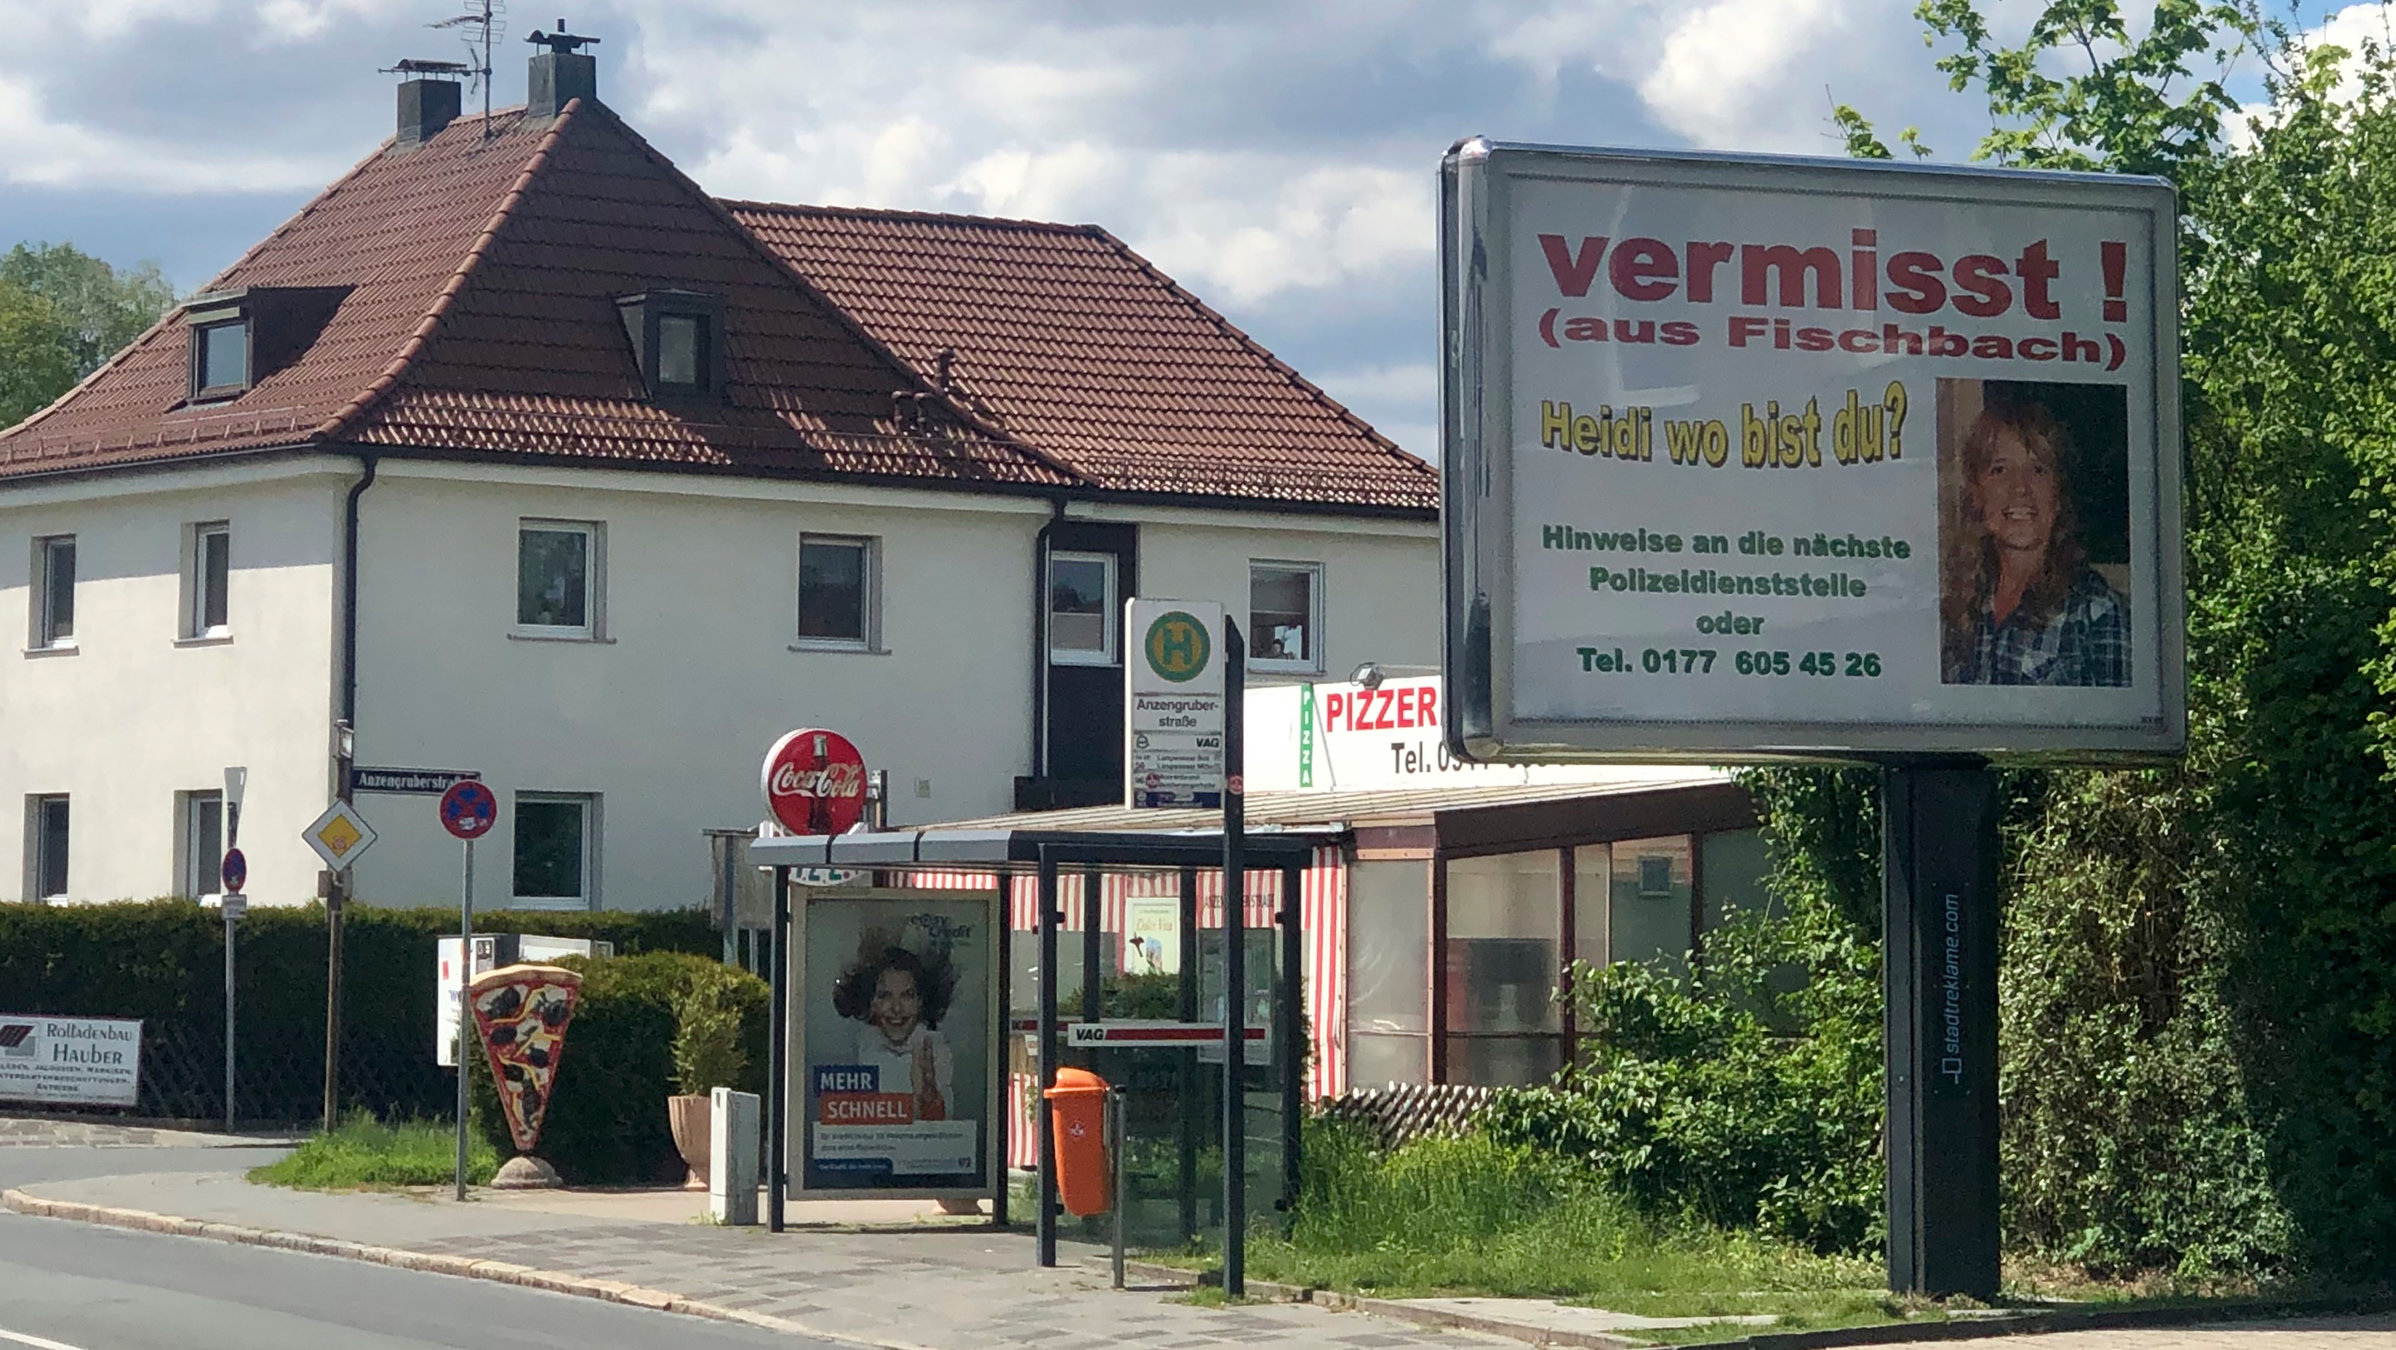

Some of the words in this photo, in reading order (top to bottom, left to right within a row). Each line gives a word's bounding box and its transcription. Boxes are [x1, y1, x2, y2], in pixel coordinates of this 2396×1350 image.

[1538, 229, 2061, 320] vermisst
[2101, 242, 2127, 323] !
[1539, 308, 1700, 349] (aus
[1728, 315, 2126, 371] Fischbach)
[1541, 400, 1652, 462] Heidi
[1665, 419, 1729, 467] wo
[1741, 395, 1822, 468] bist
[1833, 380, 1907, 464] du?
[1543, 524, 1683, 553] Hinweise
[1692, 534, 1729, 554] an
[1738, 531, 1784, 556] die
[1793, 533, 1911, 559] nächste
[1589, 566, 1867, 597] Polizeidienststelle
[1696, 611, 1765, 636] oder
[1576, 647, 1633, 673] Tel.
[1642, 649, 1717, 674] 0177
[1735, 651, 1790, 676] 605
[1799, 652, 1836, 676] 45
[1845, 652, 1882, 677] 26
[1136, 699, 1219, 713] Anzengruber-
[1158, 715, 1198, 727] straße
[1196, 738, 1220, 748] VAG
[1302, 690, 1311, 785] PIZZA
[1391, 741, 1431, 774] Tel.
[1943, 893, 1960, 1055] stadtreklame.com
[1075, 1028, 1104, 1041] VAG
[820, 1072, 872, 1090] MEHR
[827, 1101, 908, 1119] SCHNELL
